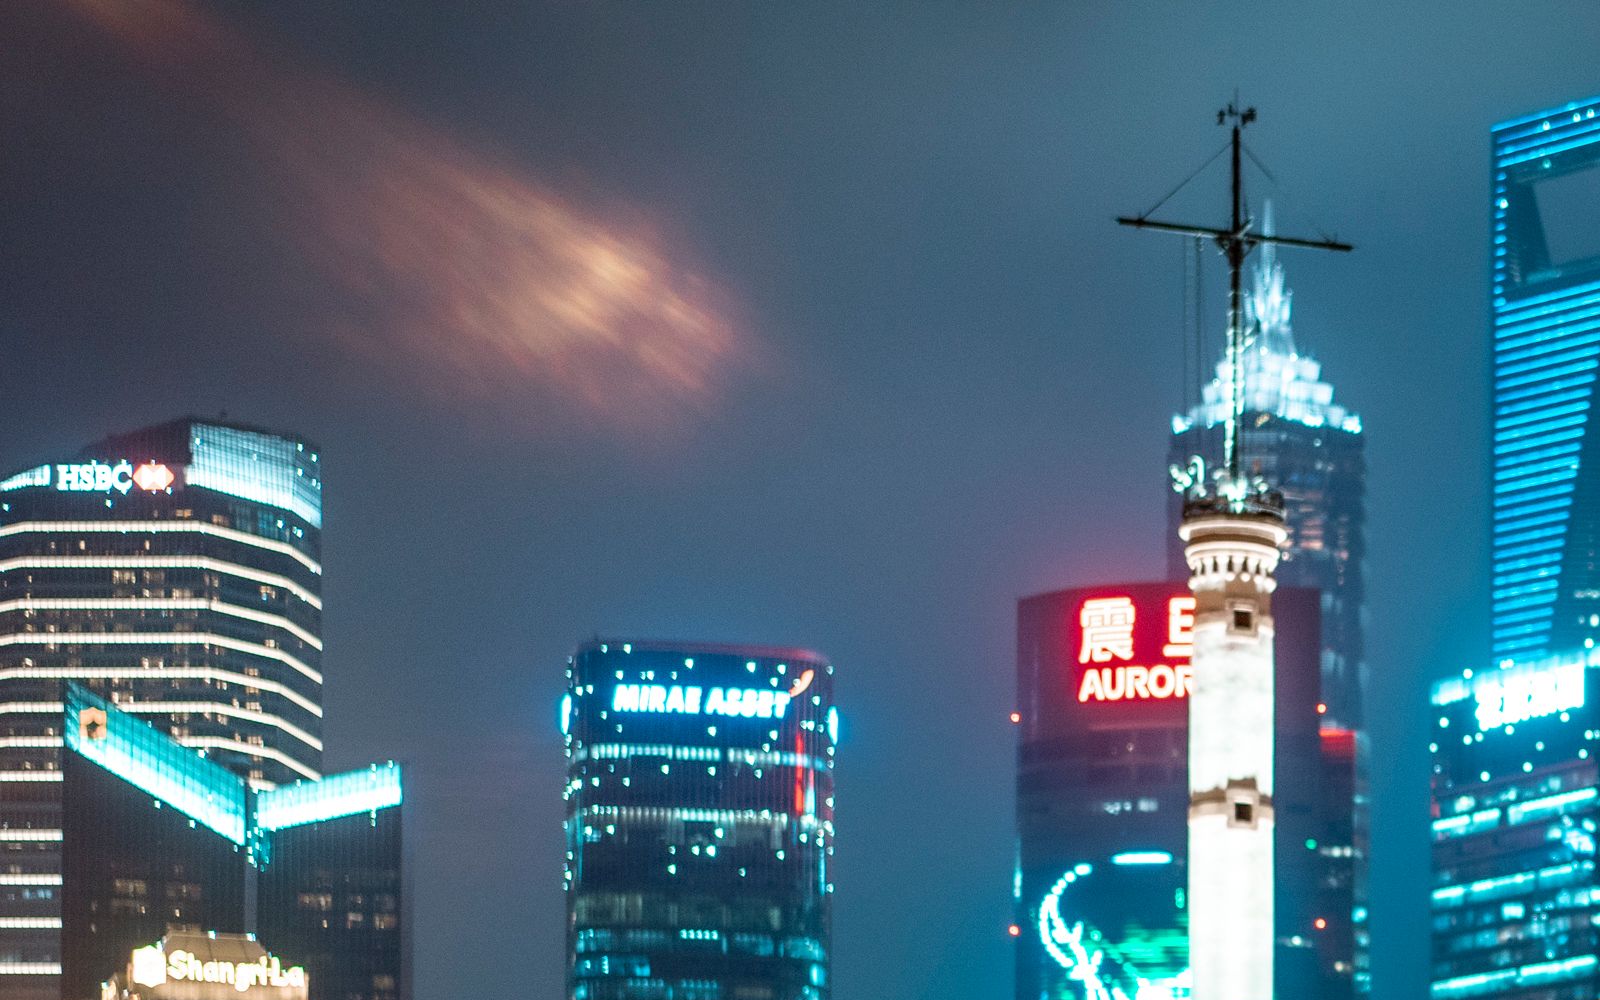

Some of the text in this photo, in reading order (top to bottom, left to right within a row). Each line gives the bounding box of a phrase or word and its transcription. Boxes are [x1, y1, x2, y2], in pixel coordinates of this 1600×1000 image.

[56, 464, 133, 491] HSBC
[613, 684, 791, 718] MIRAE ASSET
[167, 949, 304, 992] Shangri-La
